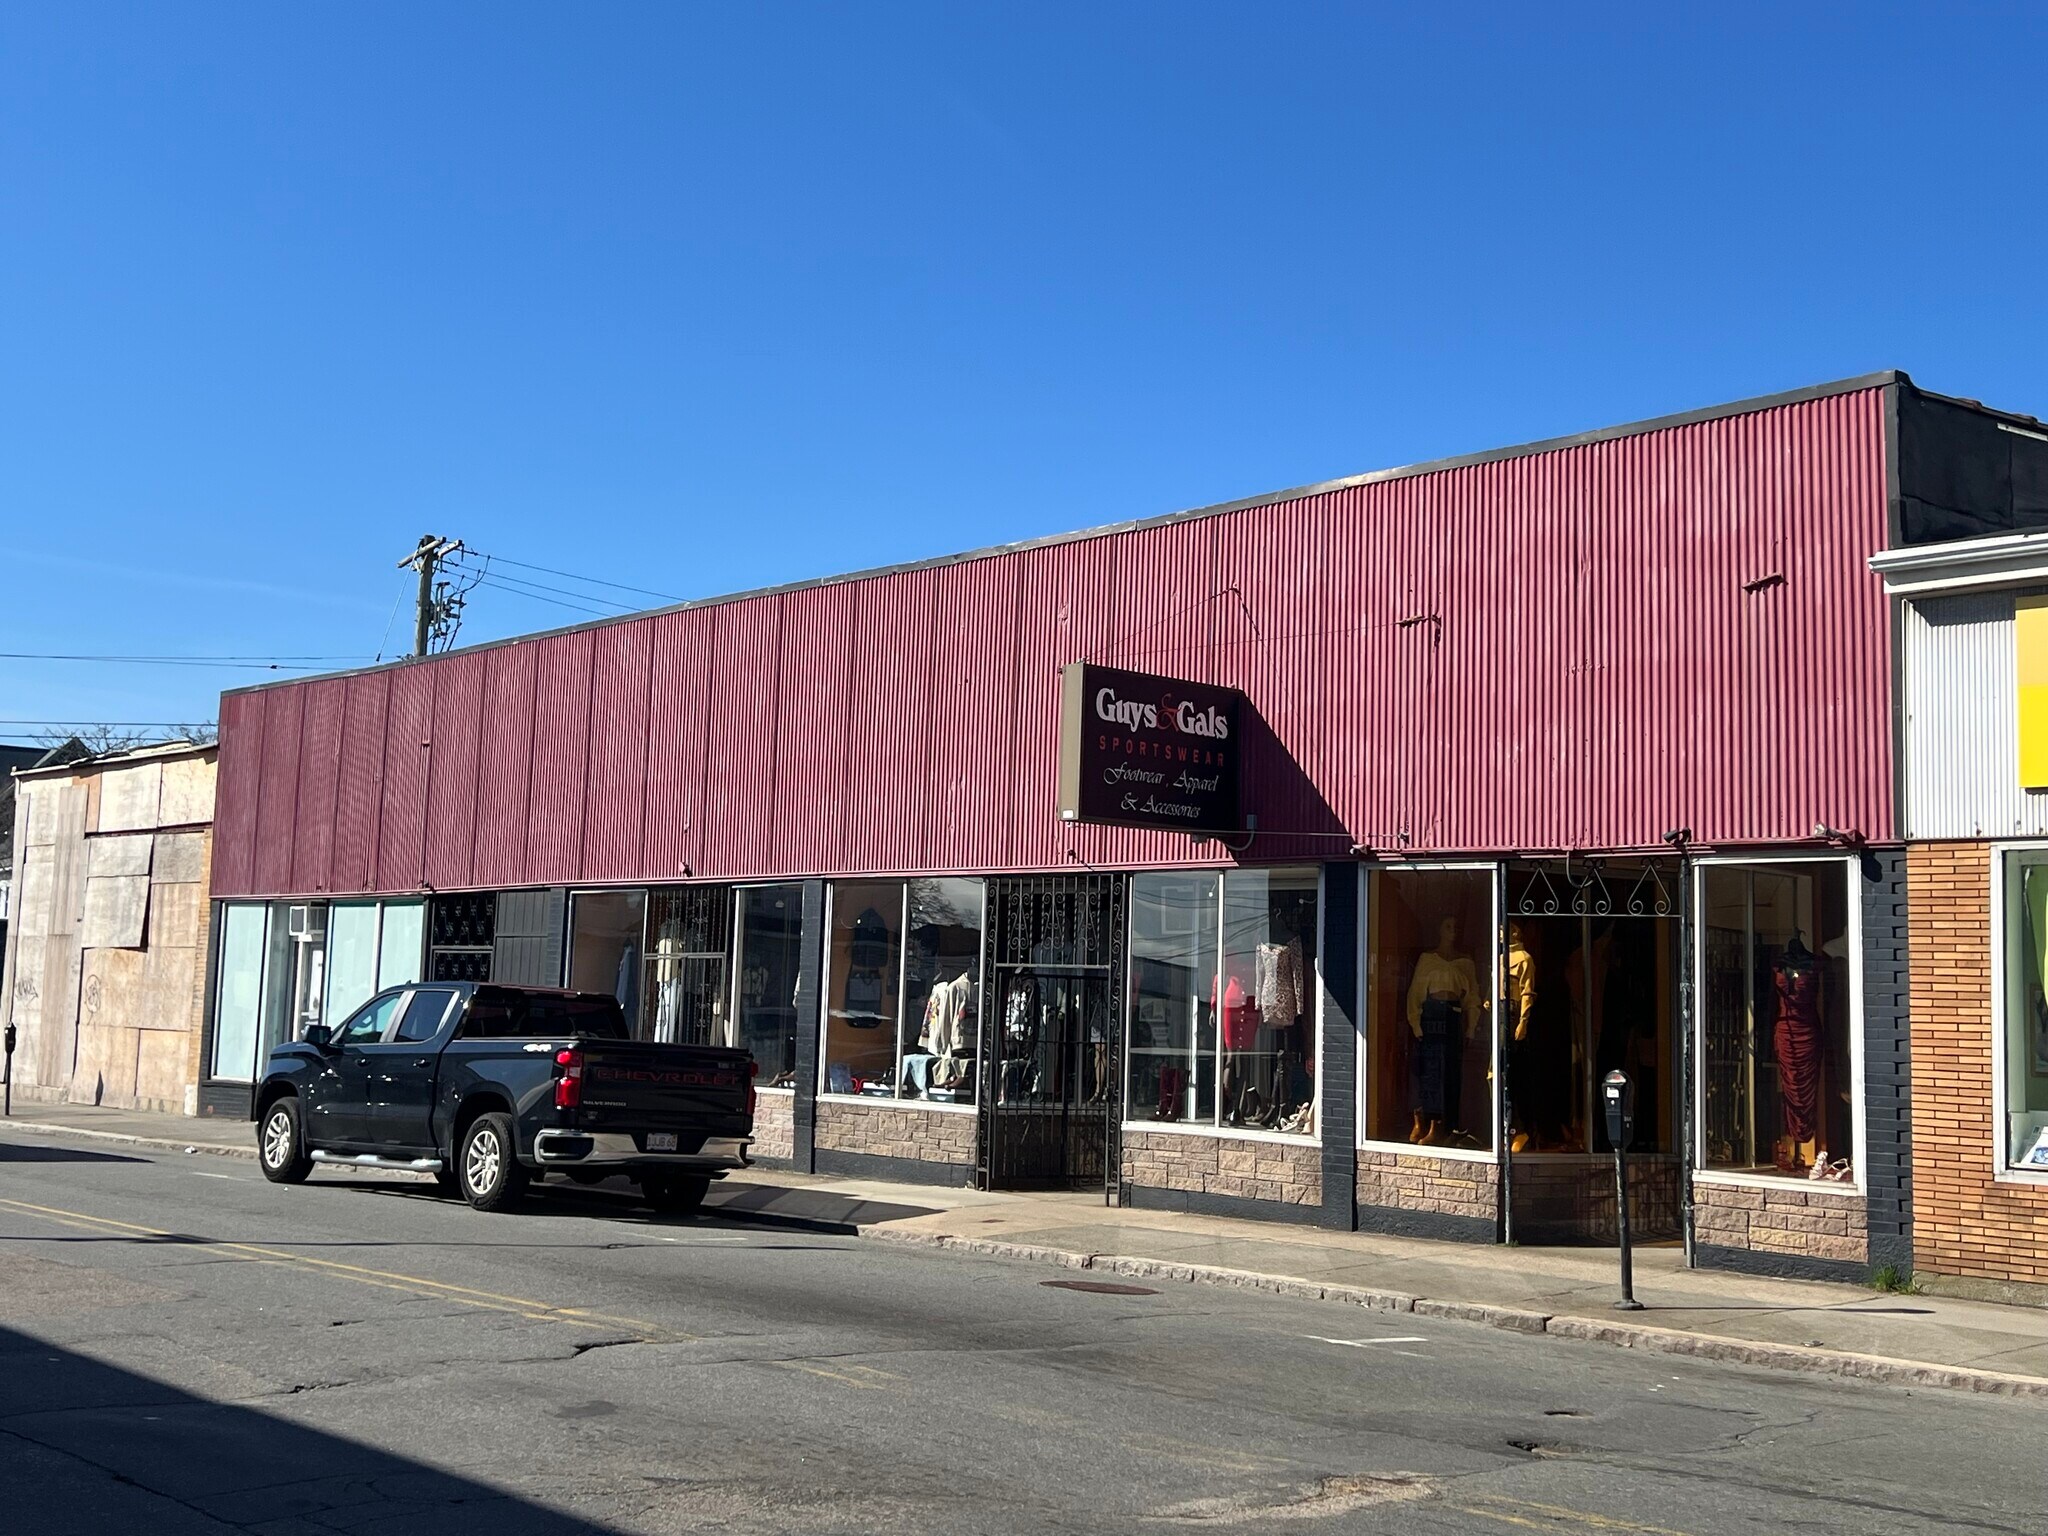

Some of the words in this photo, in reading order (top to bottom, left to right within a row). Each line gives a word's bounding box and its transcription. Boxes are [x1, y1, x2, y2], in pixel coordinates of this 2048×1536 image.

[1095, 687, 1157, 733] Guys
[1177, 701, 1228, 740] Gals
[1099, 735, 1224, 767] SPORTSWEAR
[1173, 769, 1219, 794] Apparel
[1120, 792, 1139, 811] &
[1140, 794, 1201, 819] Accessories
[596, 1066, 740, 1086] CHEVROLET
